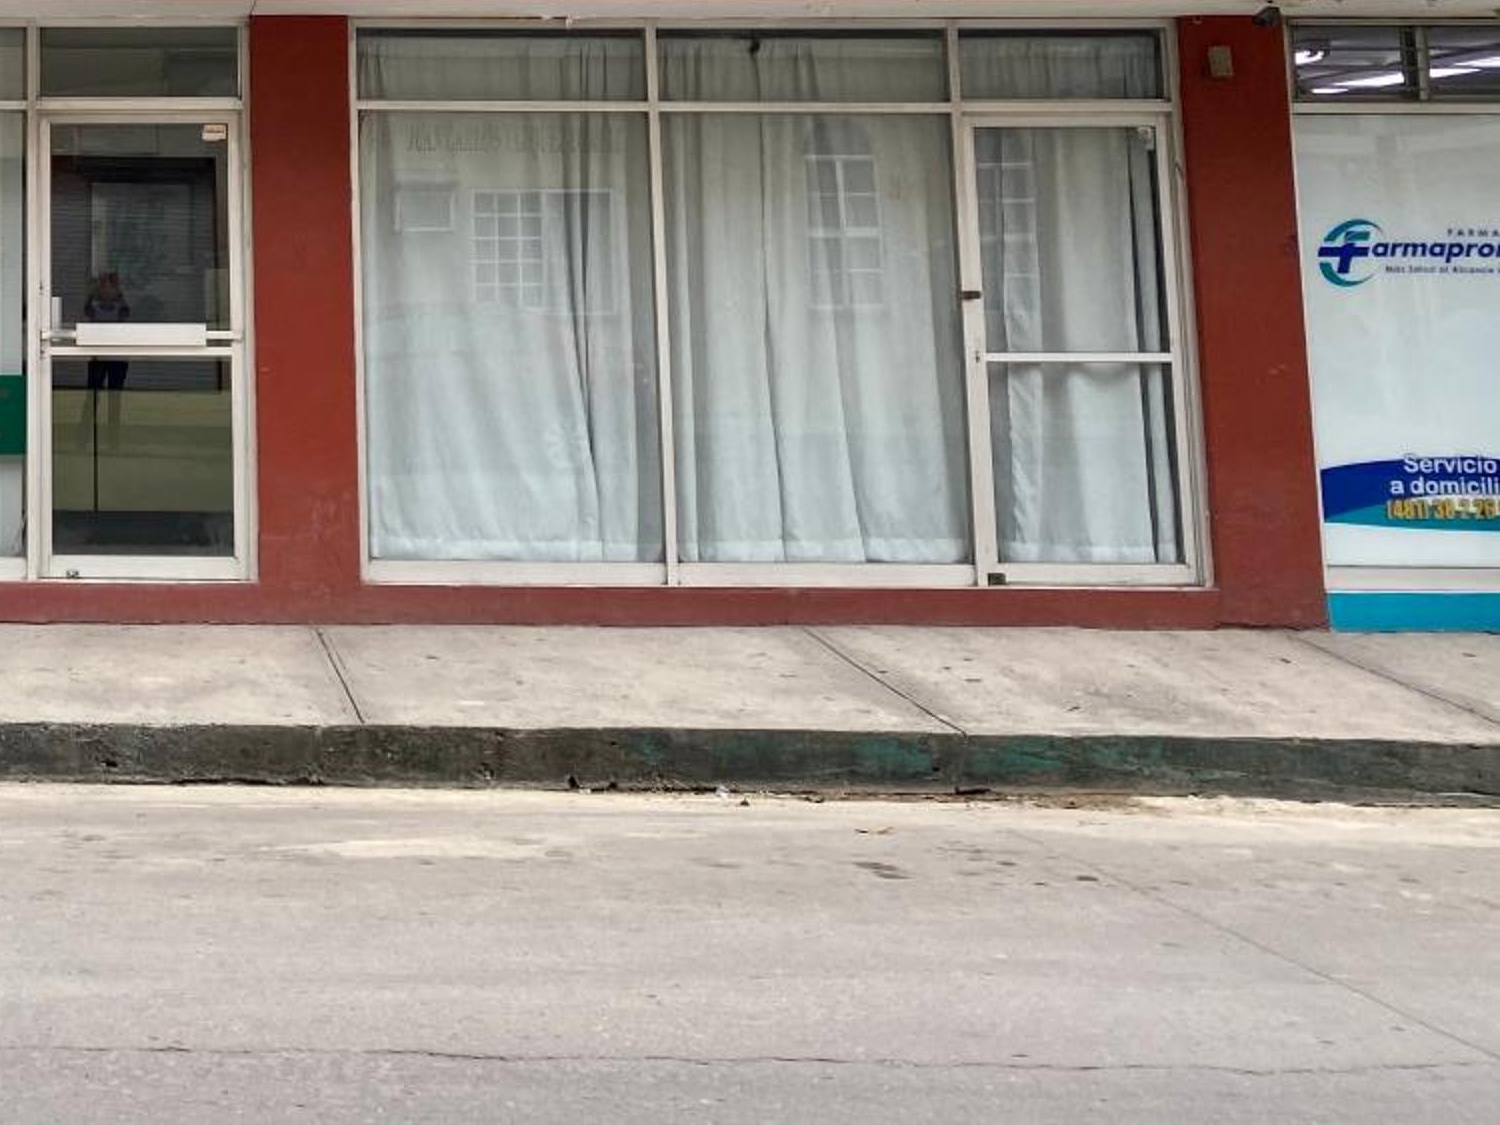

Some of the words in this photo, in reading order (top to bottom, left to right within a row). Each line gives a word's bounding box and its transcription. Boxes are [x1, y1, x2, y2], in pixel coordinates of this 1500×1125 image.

[1402, 456, 1498, 474] Servicio
[1389, 479, 1405, 495] a
[1410, 475, 1500, 495] domicili
